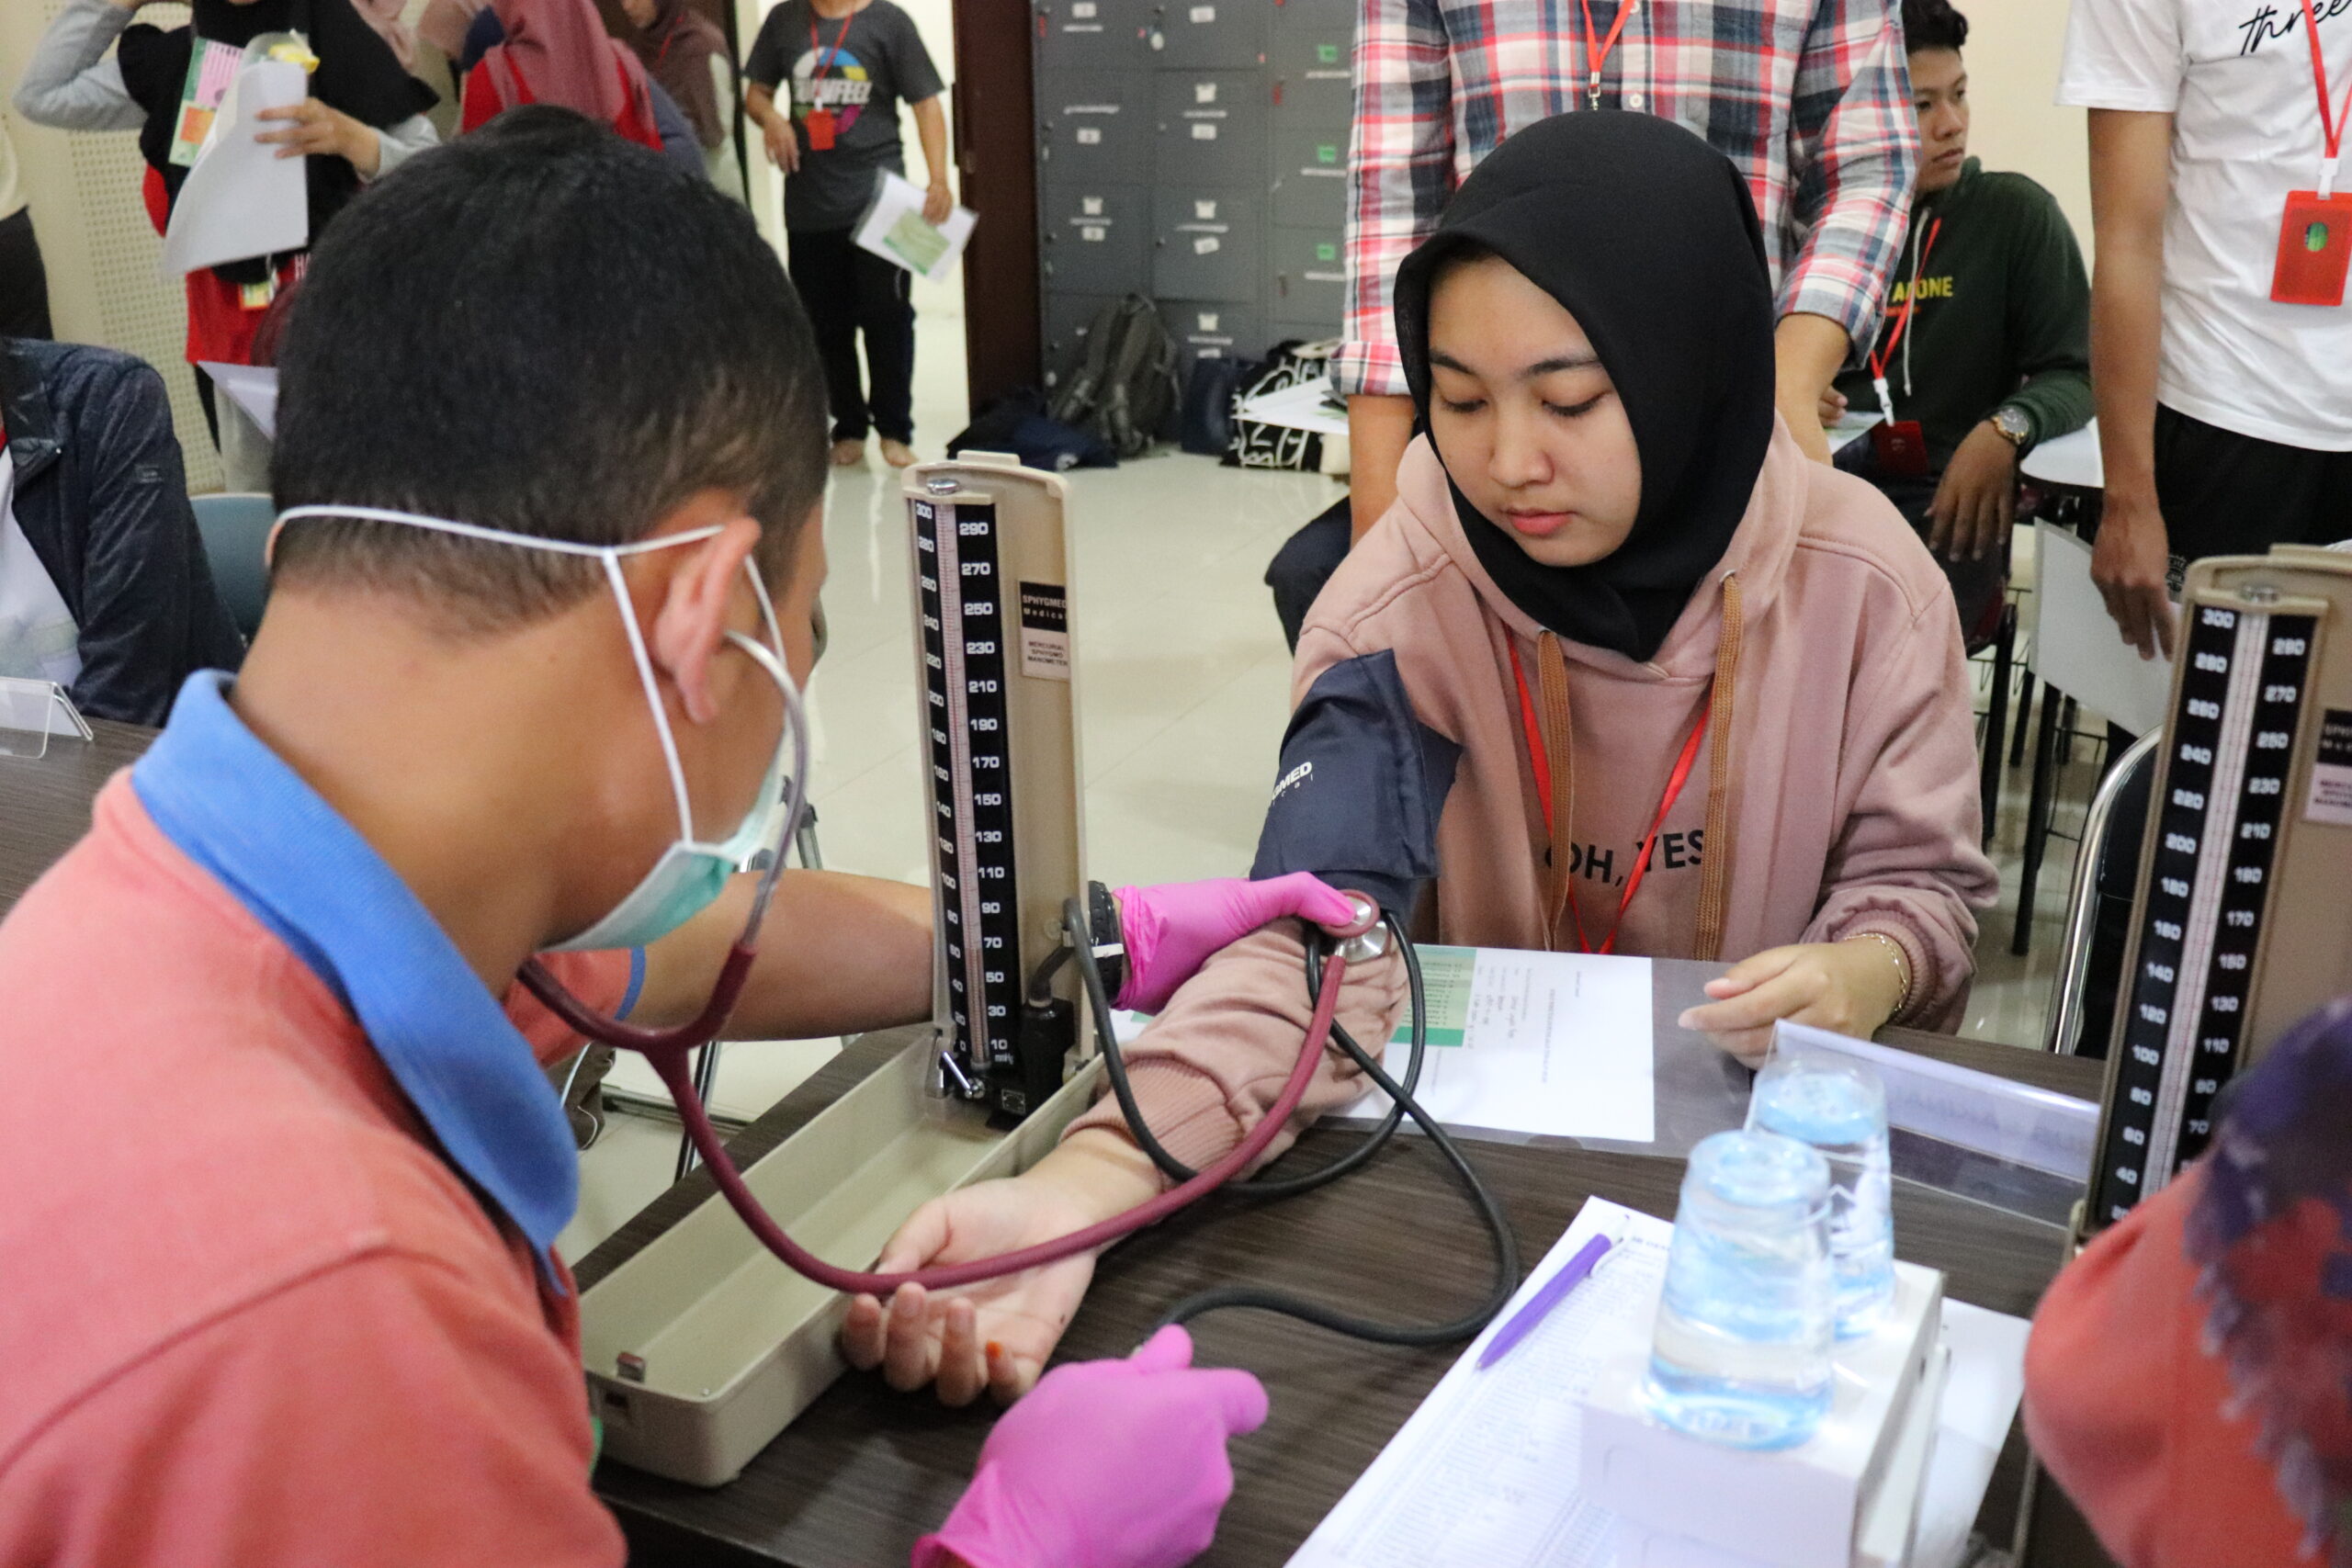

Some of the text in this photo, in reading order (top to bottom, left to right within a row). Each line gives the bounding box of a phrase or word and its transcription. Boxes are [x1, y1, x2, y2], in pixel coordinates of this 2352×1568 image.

[959, 523, 989, 536] 290
[962, 562, 990, 575] 270
[965, 603, 992, 615] 250
[2201, 608, 2234, 629] 300
[967, 642, 995, 654] 230
[969, 681, 997, 693] 210
[2265, 685, 2296, 702] 270
[971, 718, 997, 730] 190
[972, 757, 1000, 769] 170
[2249, 778, 2280, 794] 230
[975, 794, 1001, 805] 150
[977, 831, 1001, 842] 130
[2241, 823, 2270, 839] 210
[978, 867, 1004, 878] 110
[981, 902, 1000, 913] 90
[2227, 911, 2254, 927] 170
[984, 937, 1001, 948] 70
[986, 972, 1003, 982] 50
[989, 1006, 1005, 1016] 30
[991, 1040, 1007, 1049] 10
[2204, 1039, 2229, 1053] 110
[2189, 1120, 2210, 1134] 70
